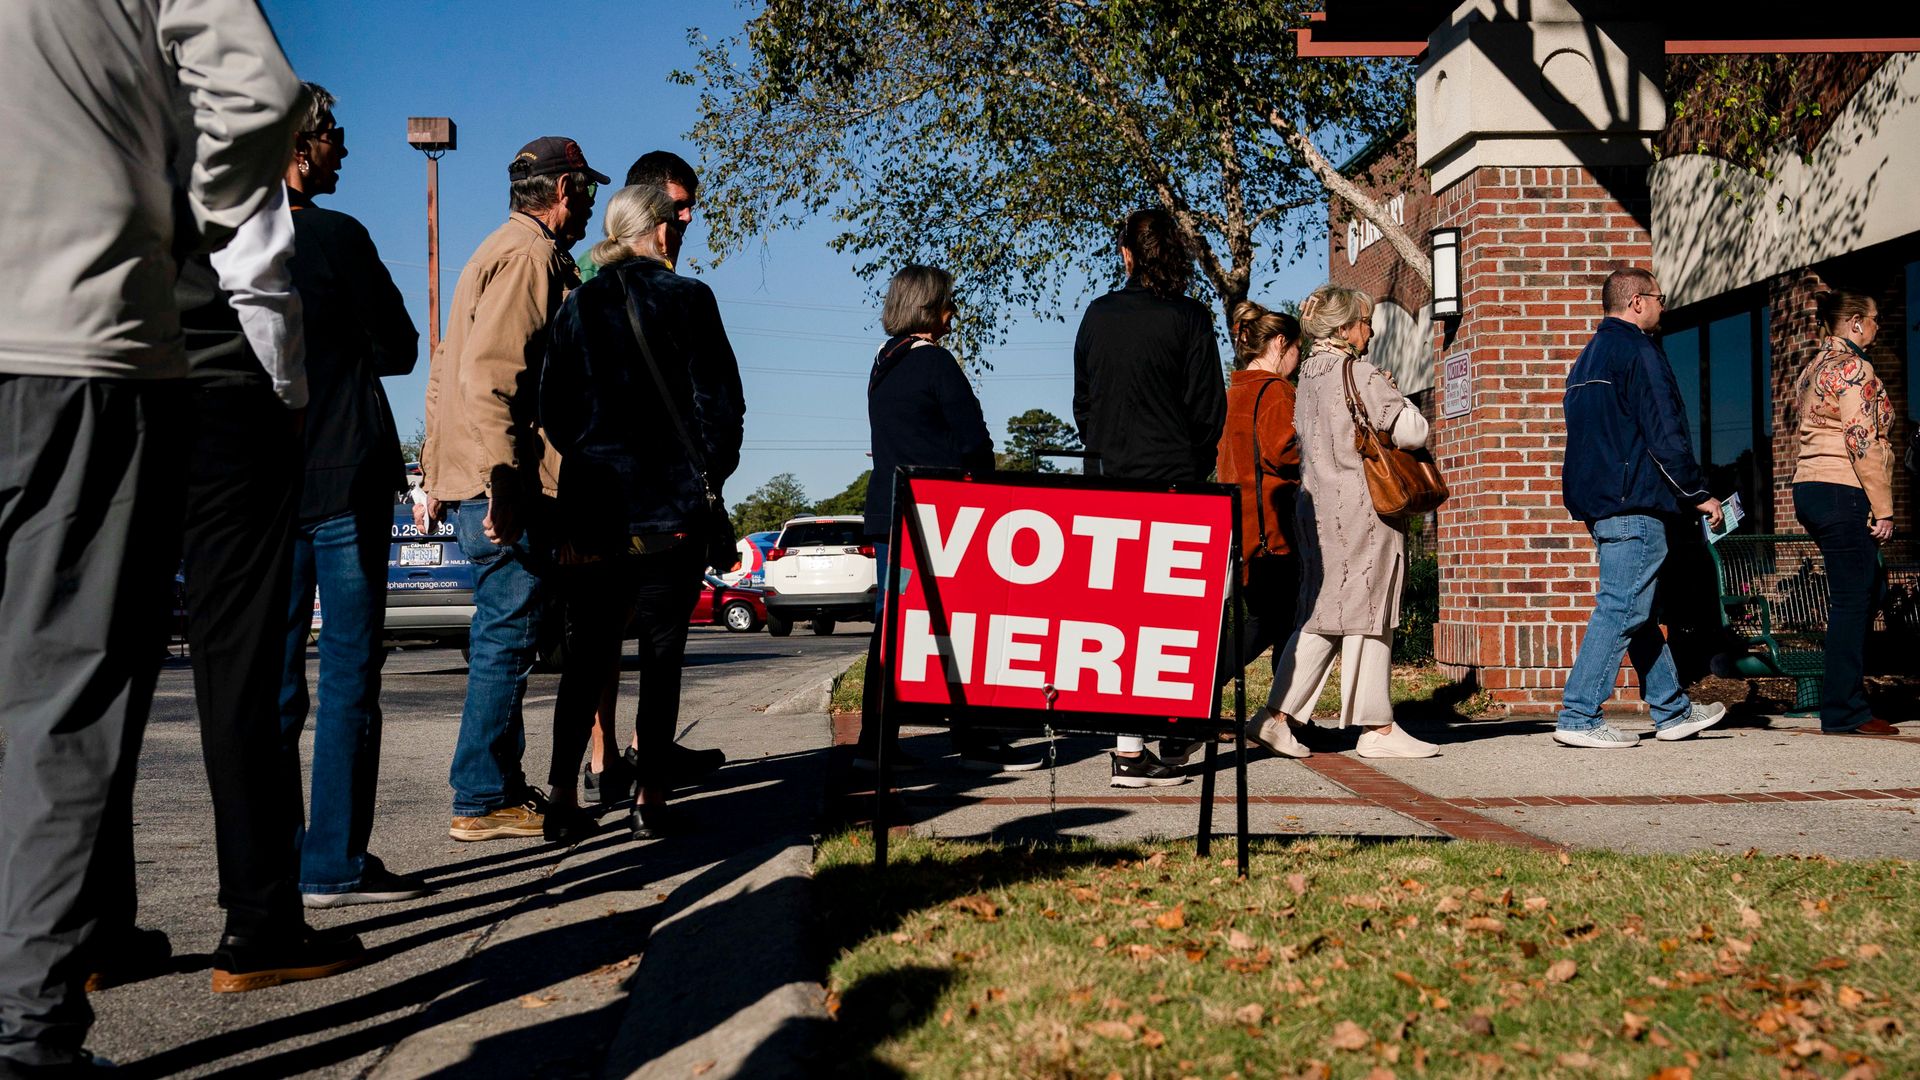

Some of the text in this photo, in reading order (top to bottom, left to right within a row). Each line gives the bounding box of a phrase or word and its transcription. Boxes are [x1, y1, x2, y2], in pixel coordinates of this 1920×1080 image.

[1448, 359, 1467, 379] NOTICE
[911, 503, 1212, 598] VOTE
[900, 609, 1200, 701] HERE
